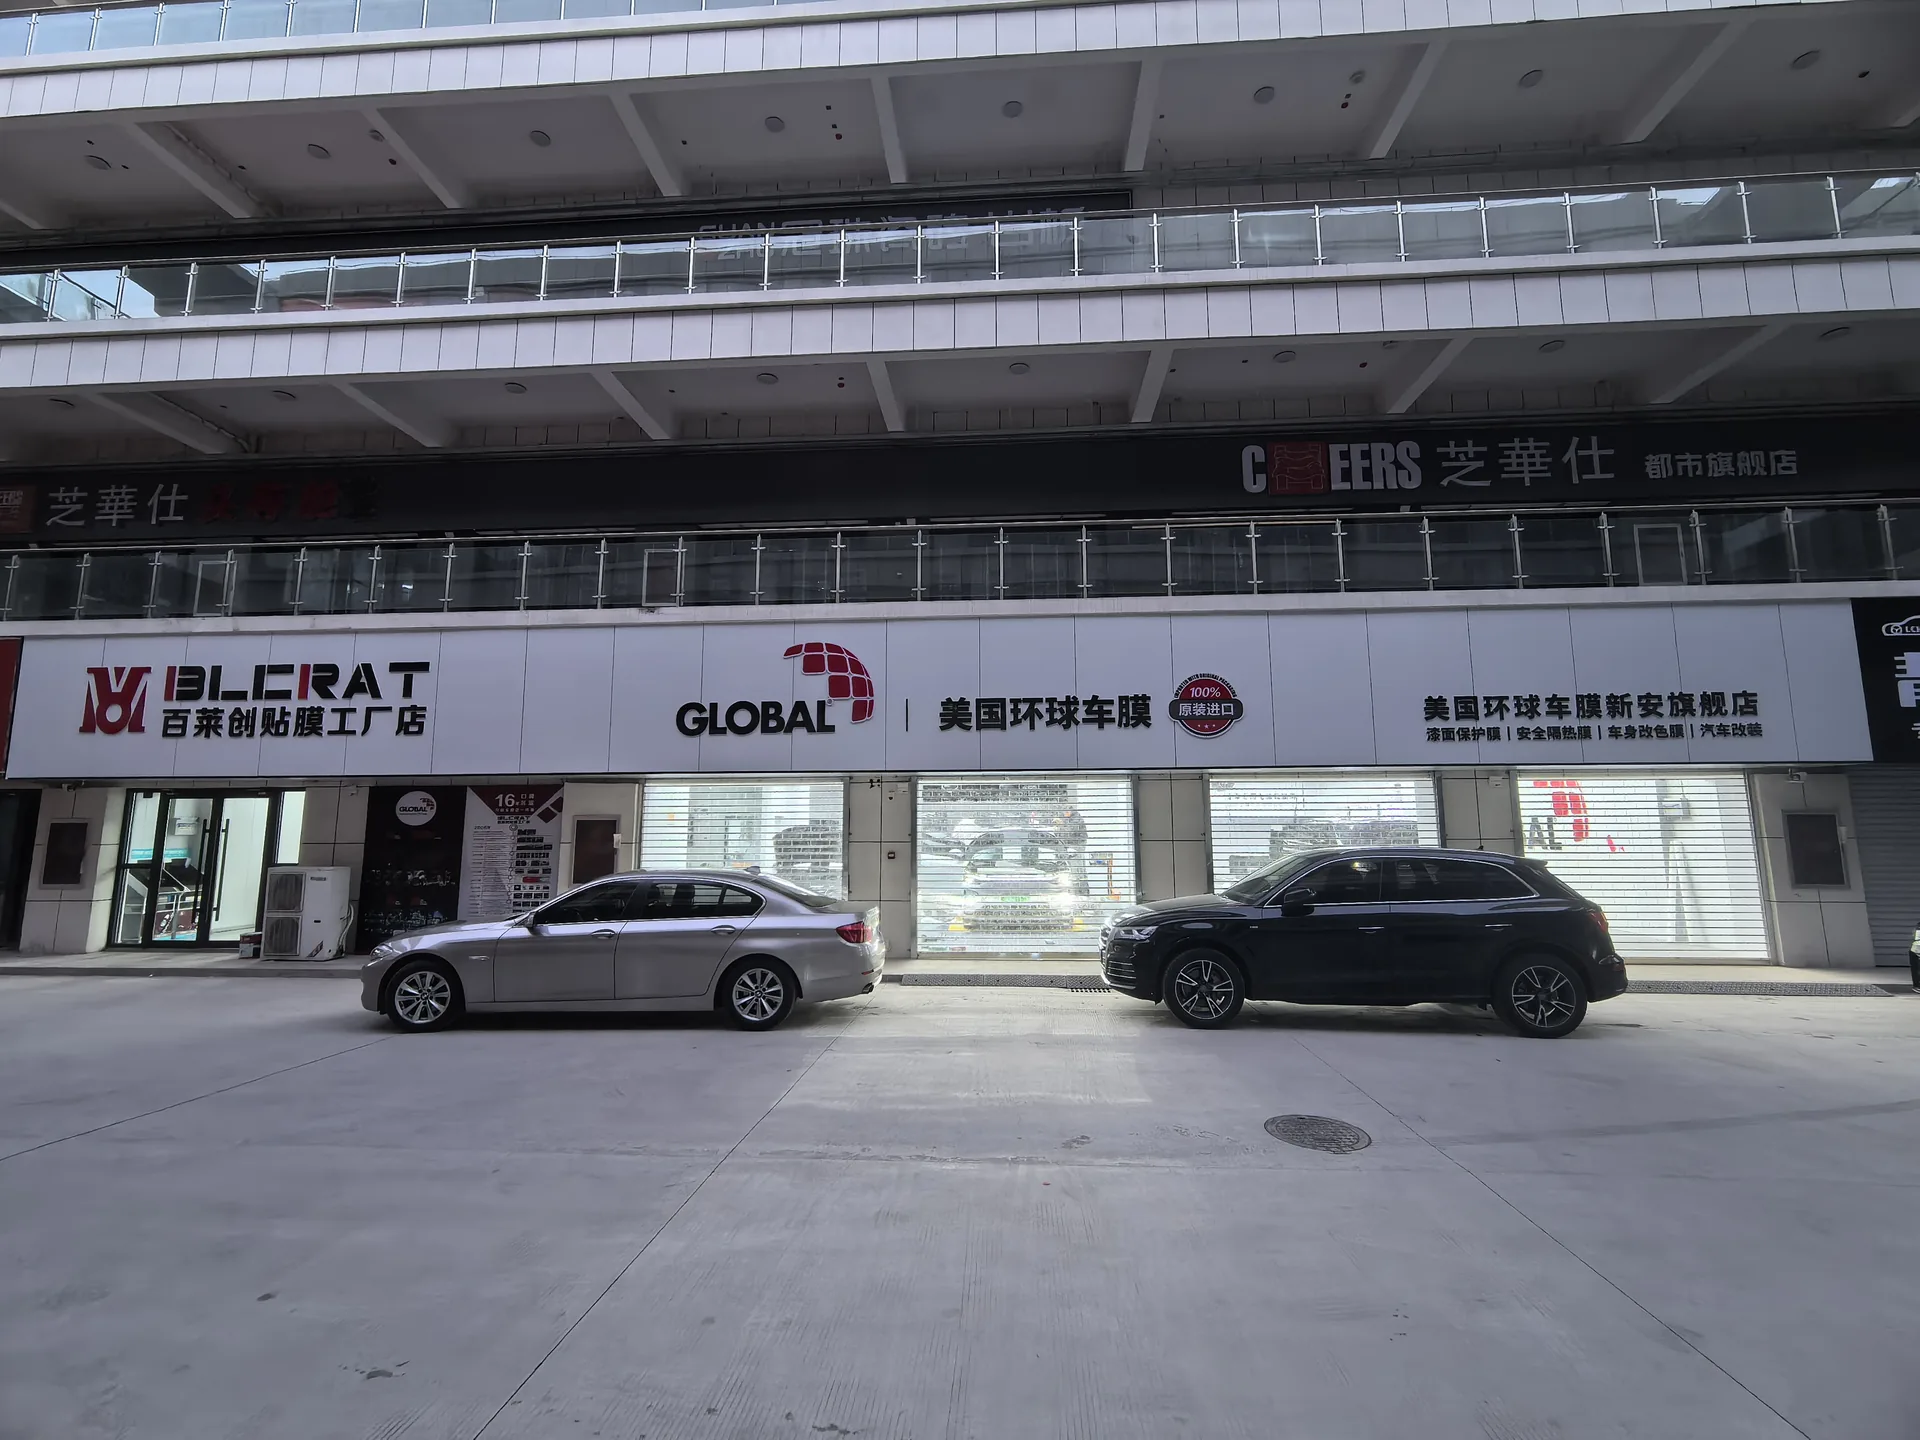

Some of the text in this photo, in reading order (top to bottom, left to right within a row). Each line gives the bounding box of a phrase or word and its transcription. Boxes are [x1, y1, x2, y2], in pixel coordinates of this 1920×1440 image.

[1436, 435, 1616, 488] 芝華仕
[1644, 449, 1798, 481] 都市旗舰店
[45, 483, 189, 527] 芝華仕
[164, 661, 430, 701] BLCRAT
[1189, 686, 1221, 698] 100%
[162, 705, 427, 739] 百莱创贴膜工厂店
[676, 698, 836, 737] GLOBAL
[939, 693, 1152, 731] 美国环球车膜
[1178, 702, 1234, 716] 原装进口
[1423, 690, 1758, 721] 美国环球车膜新安旗舰店
[1426, 721, 1763, 742] 漆面保护膜 安全隔热膜 车身改色膜 汽车改装
[495, 793, 515, 807] 16
[1523, 817, 1563, 851] AL
